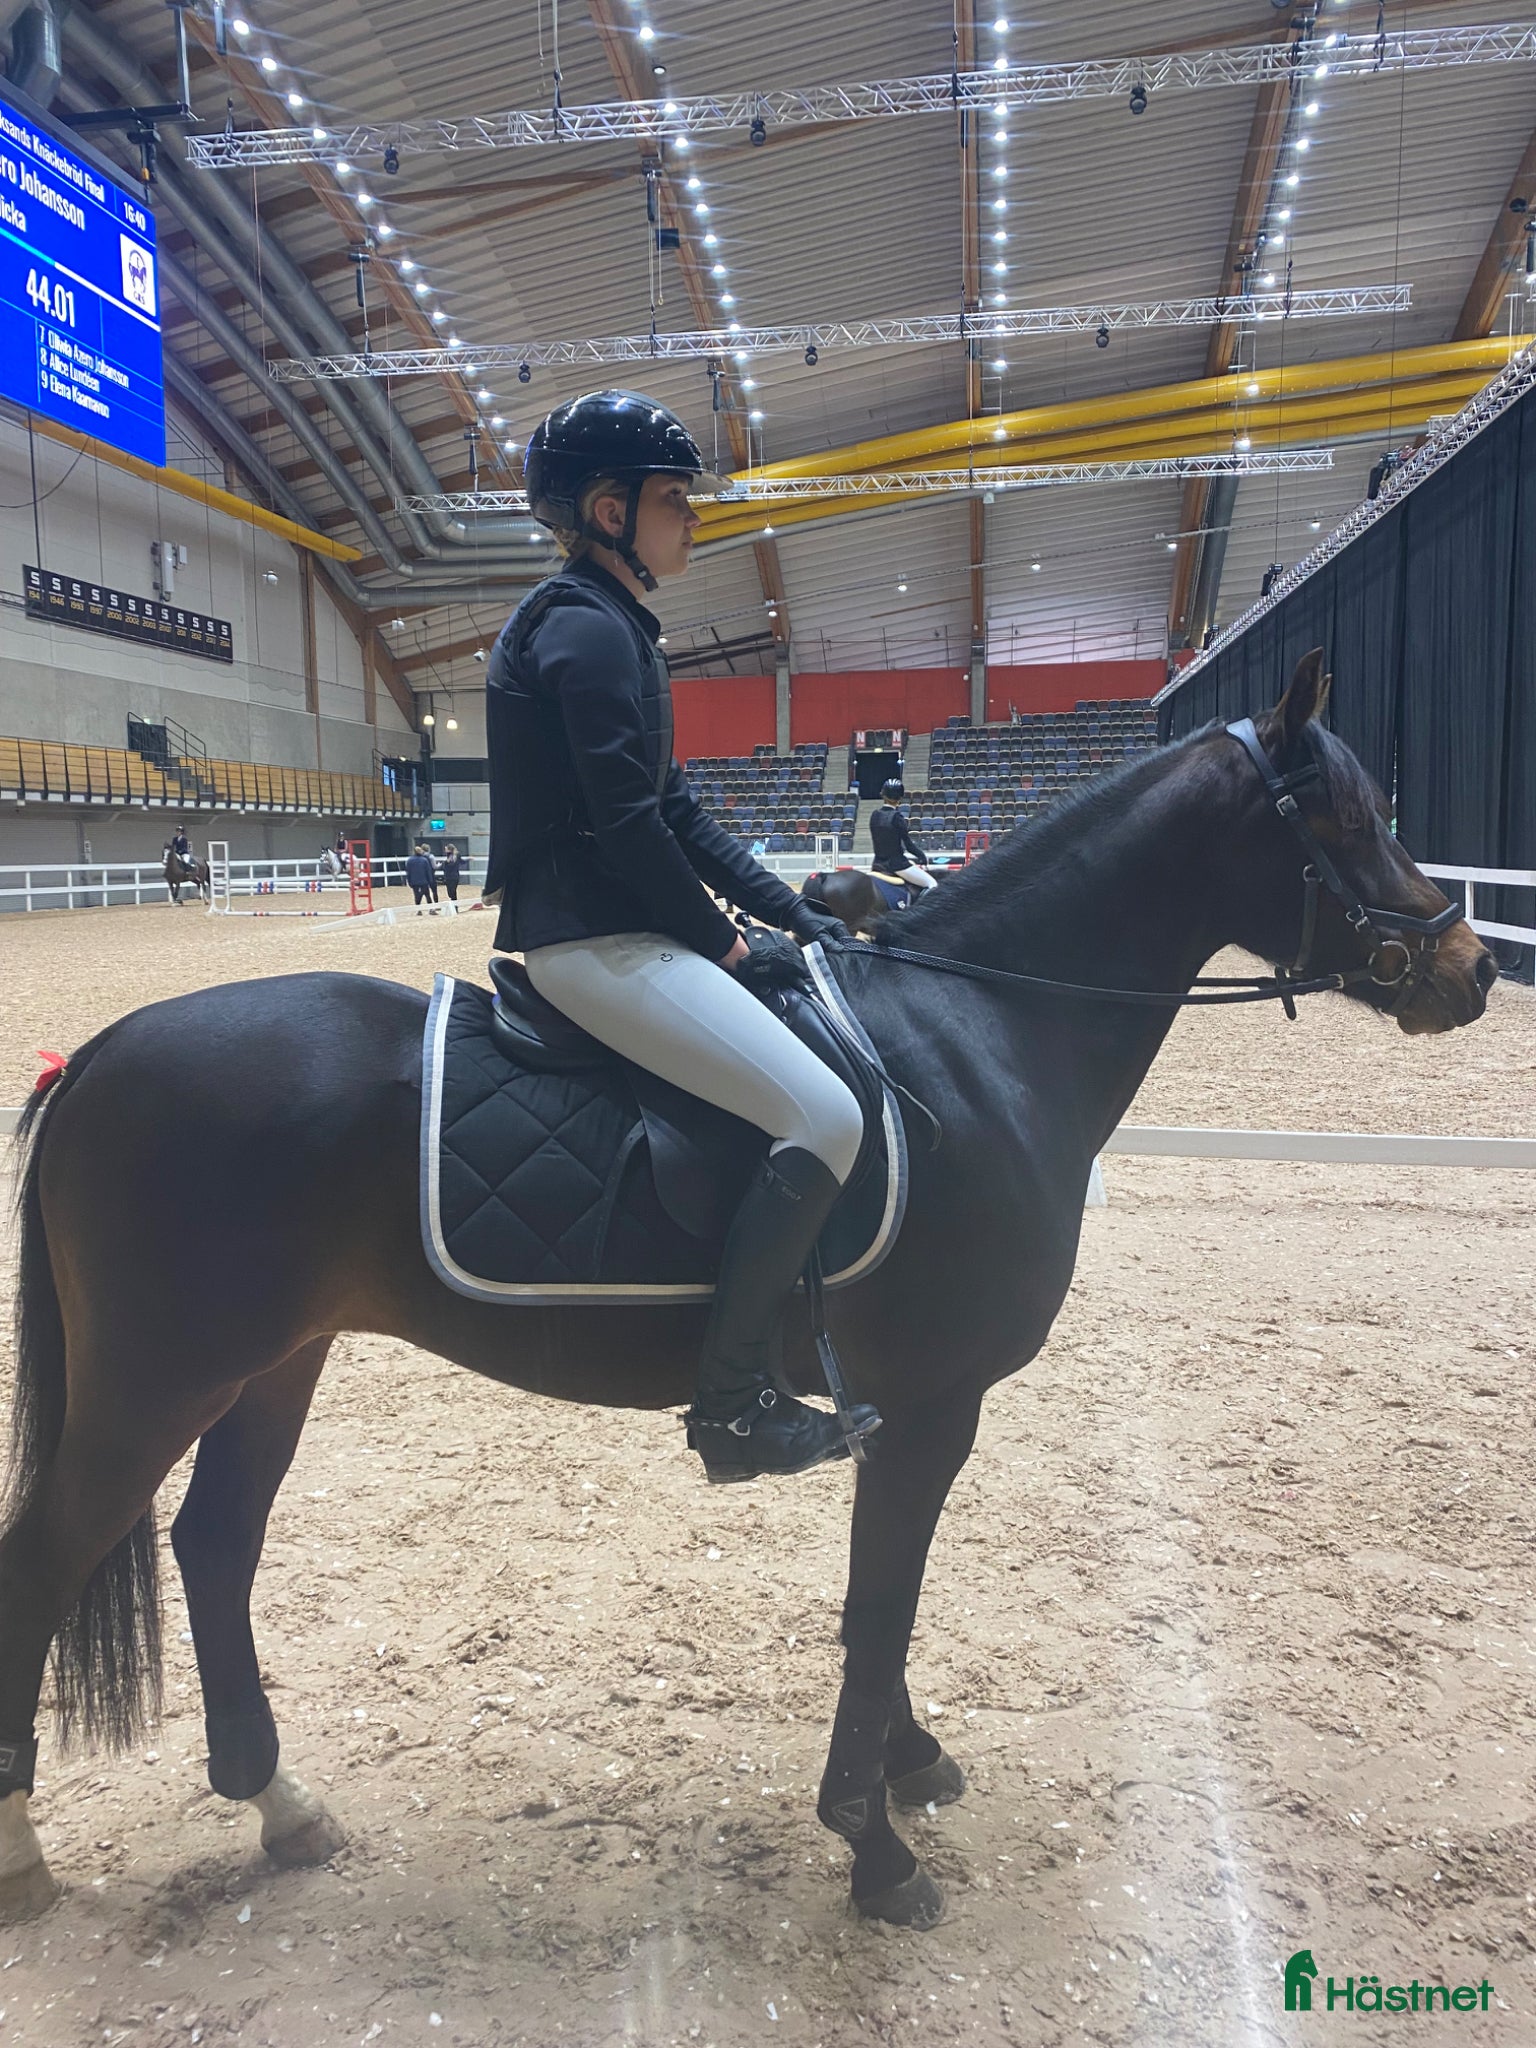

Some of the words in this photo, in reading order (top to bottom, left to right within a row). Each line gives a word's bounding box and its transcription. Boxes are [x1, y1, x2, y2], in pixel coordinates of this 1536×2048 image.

[33, 134, 82, 187] Knäckebröd
[85, 171, 105, 203] Final
[0, 154, 17, 185] ro
[20, 161, 85, 231] Johansson
[0, 194, 26, 233] icka
[124, 201, 146, 232] 16:40
[26, 268, 75, 328] 44.01
[39, 324, 45, 343] 7
[48, 329, 73, 358] Olivia
[95, 355, 129, 388] Johansson
[40, 347, 47, 366] 8
[49, 352, 69, 377] Alice
[41, 370, 48, 389] 9
[50, 374, 71, 400] Elena
[31, 571, 40, 585] S
[52, 577, 61, 591] S
[72, 583, 80, 596] S
[91, 588, 100, 601] S
[110, 593, 118, 607] S
[128, 599, 136, 611] S
[145, 603, 152, 616] S
[161, 608, 169, 620] S
[177, 612, 185, 624] S
[192, 616, 199, 628] S
[207, 620, 214, 632] S
[221, 625, 228, 636] S
[125, 616, 140, 625] 2002
[857, 731, 865, 743] N
[893, 730, 901, 742] N
